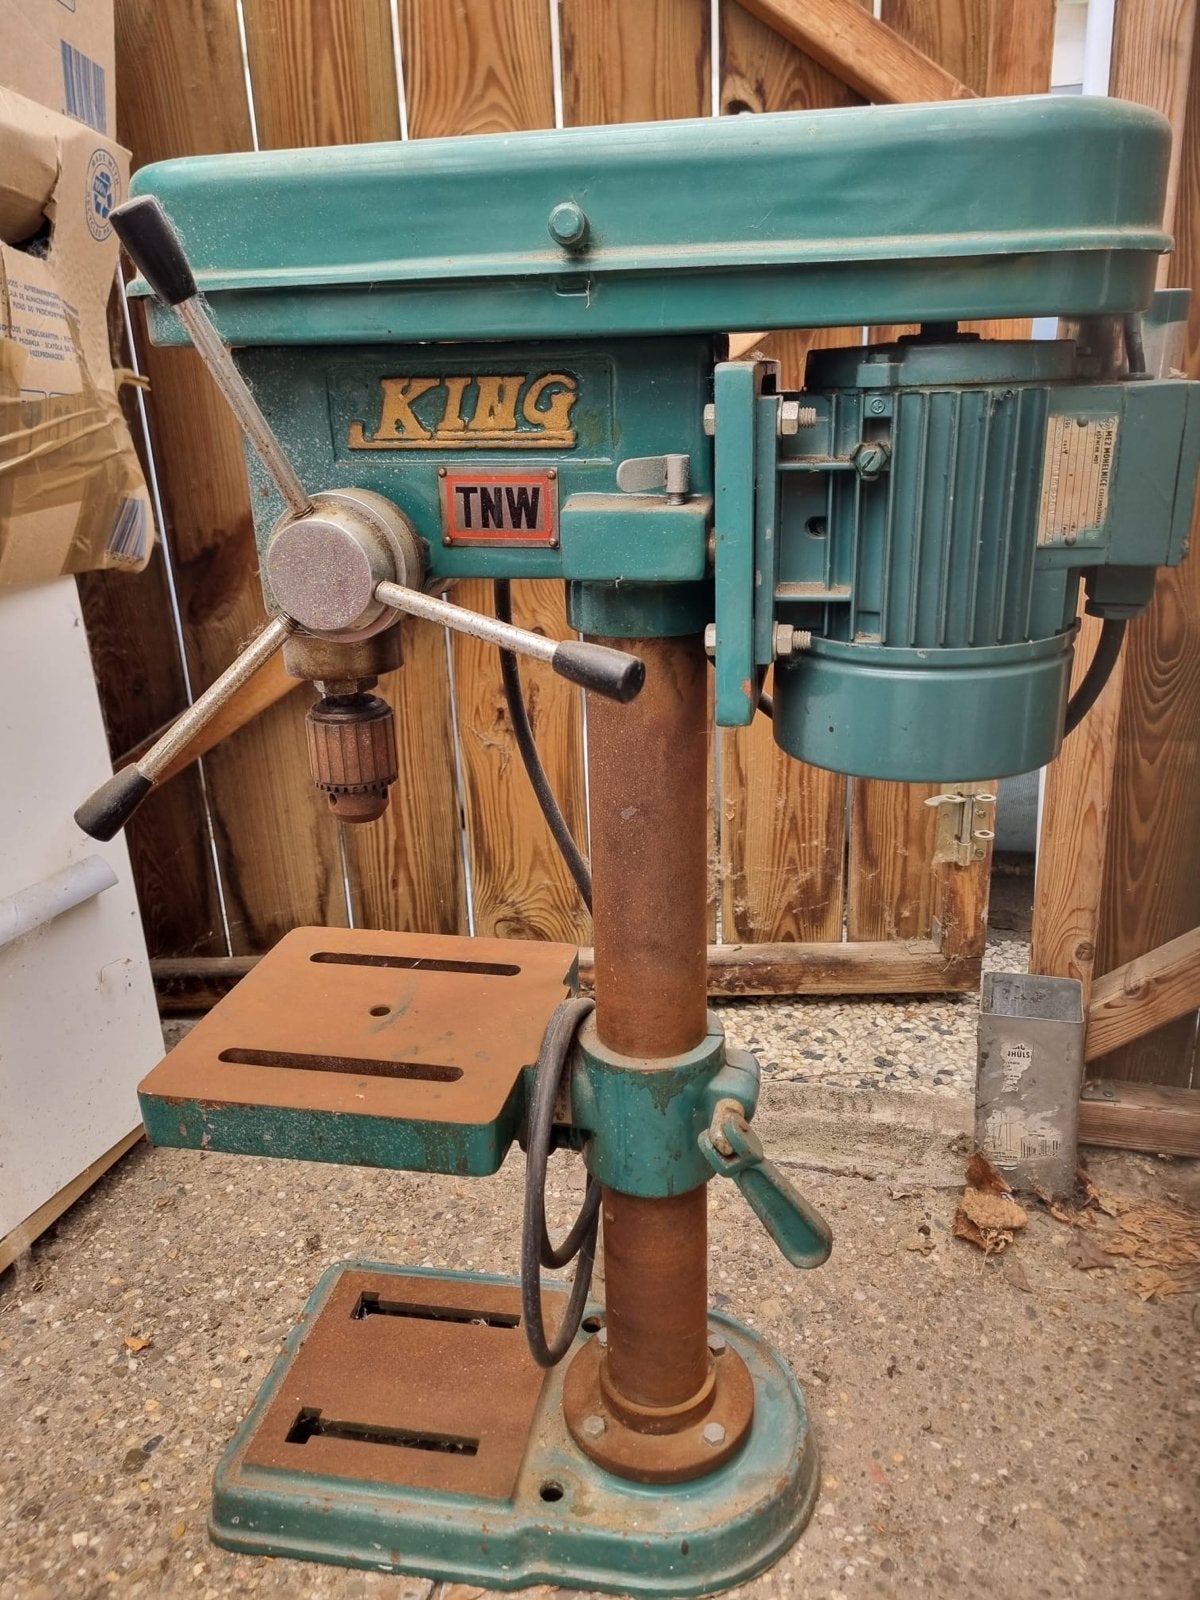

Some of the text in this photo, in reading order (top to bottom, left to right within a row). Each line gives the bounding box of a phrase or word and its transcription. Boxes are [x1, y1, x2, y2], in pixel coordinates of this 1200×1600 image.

[371, 371, 577, 438] KING
[1105, 431, 1113, 446] MEZ
[1099, 447, 1111, 487] MOHELNICE
[455, 486, 541, 529] TNW
